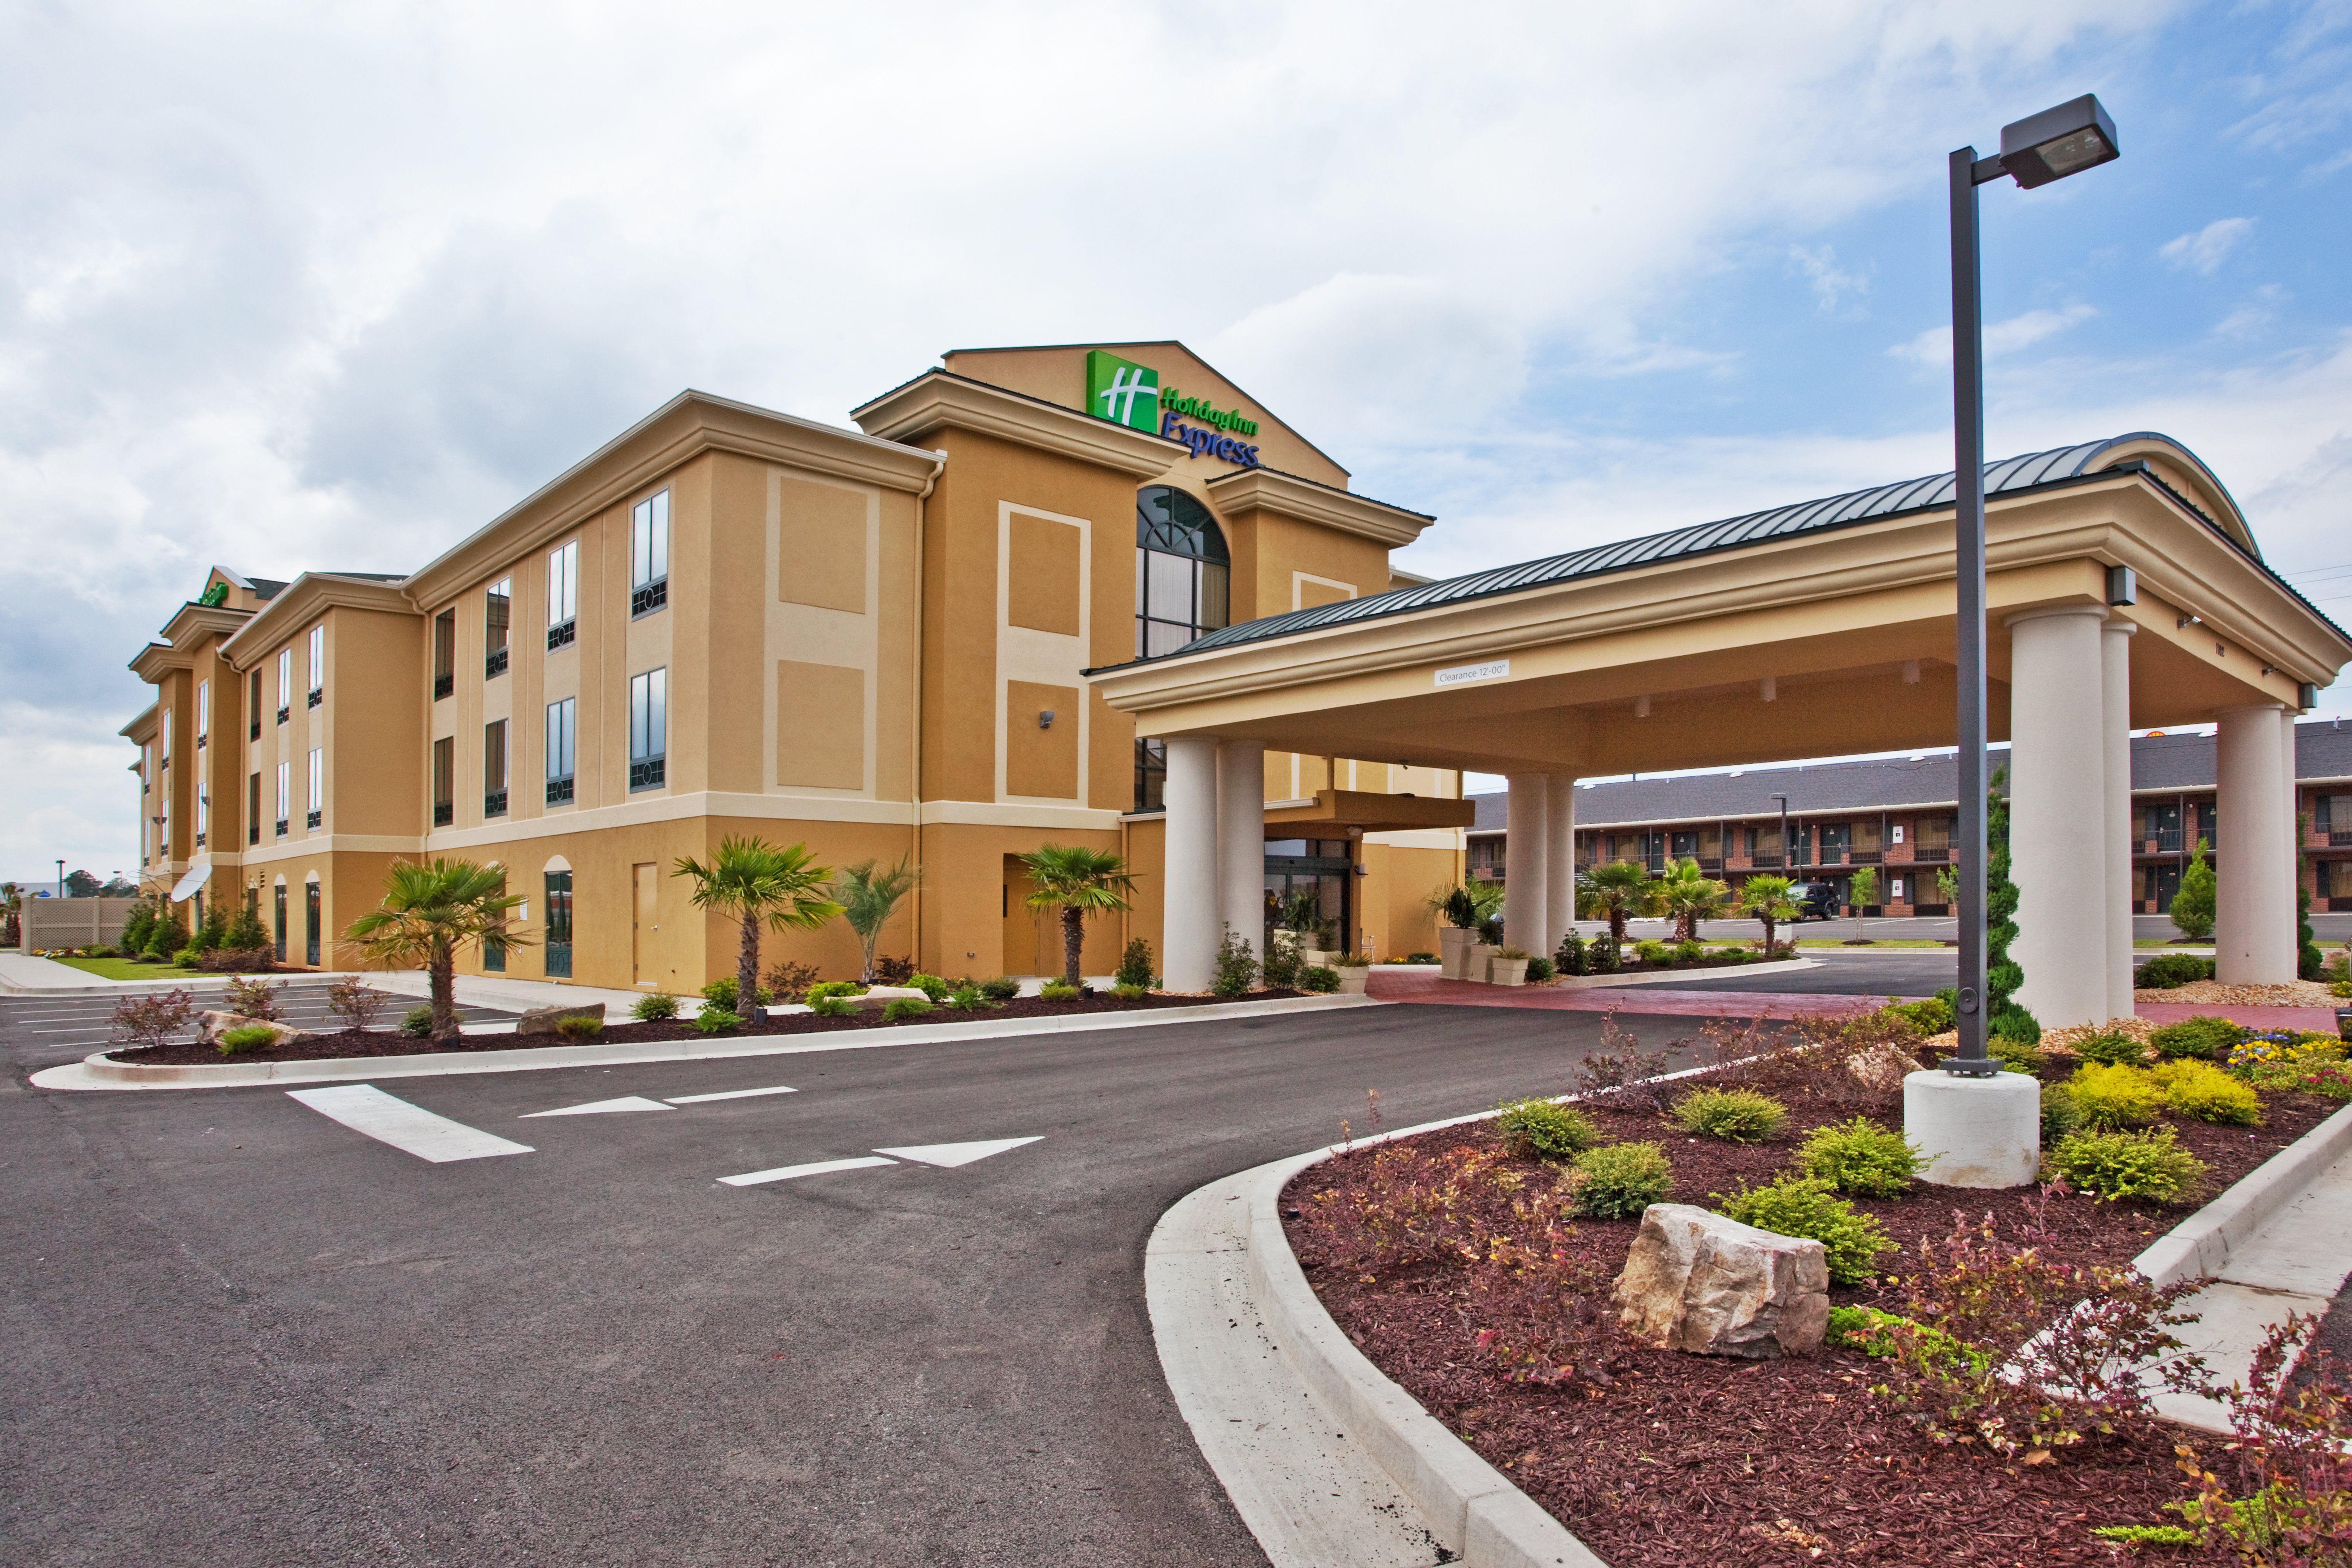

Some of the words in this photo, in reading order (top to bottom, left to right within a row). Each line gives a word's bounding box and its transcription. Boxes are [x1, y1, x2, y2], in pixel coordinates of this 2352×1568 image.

[1161, 412, 1259, 467] Express
[1440, 671, 1477, 682] Clearance
[1479, 665, 1505, 676] 12'-00"
